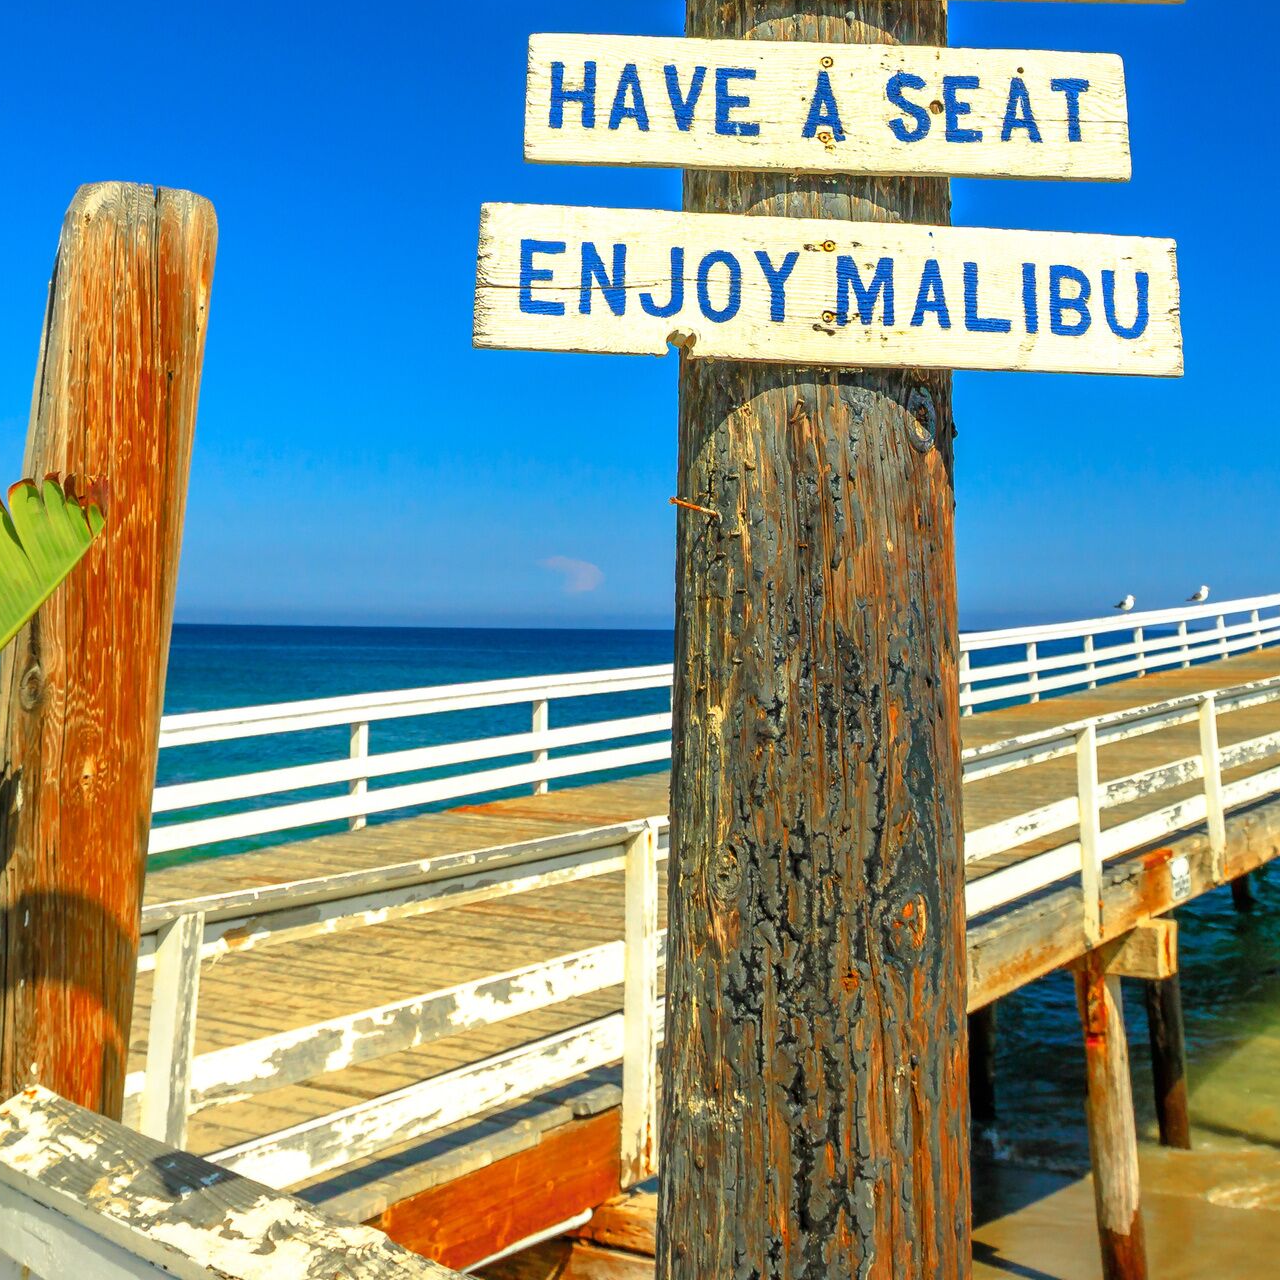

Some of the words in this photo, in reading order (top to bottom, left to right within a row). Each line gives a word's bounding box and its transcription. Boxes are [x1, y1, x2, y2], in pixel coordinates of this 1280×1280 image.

[550, 61, 759, 135] HAVE
[803, 72, 845, 141] A
[886, 73, 1088, 143] SEAT
[519, 239, 798, 322] ENJOY
[837, 256, 1148, 339] MALIBU
